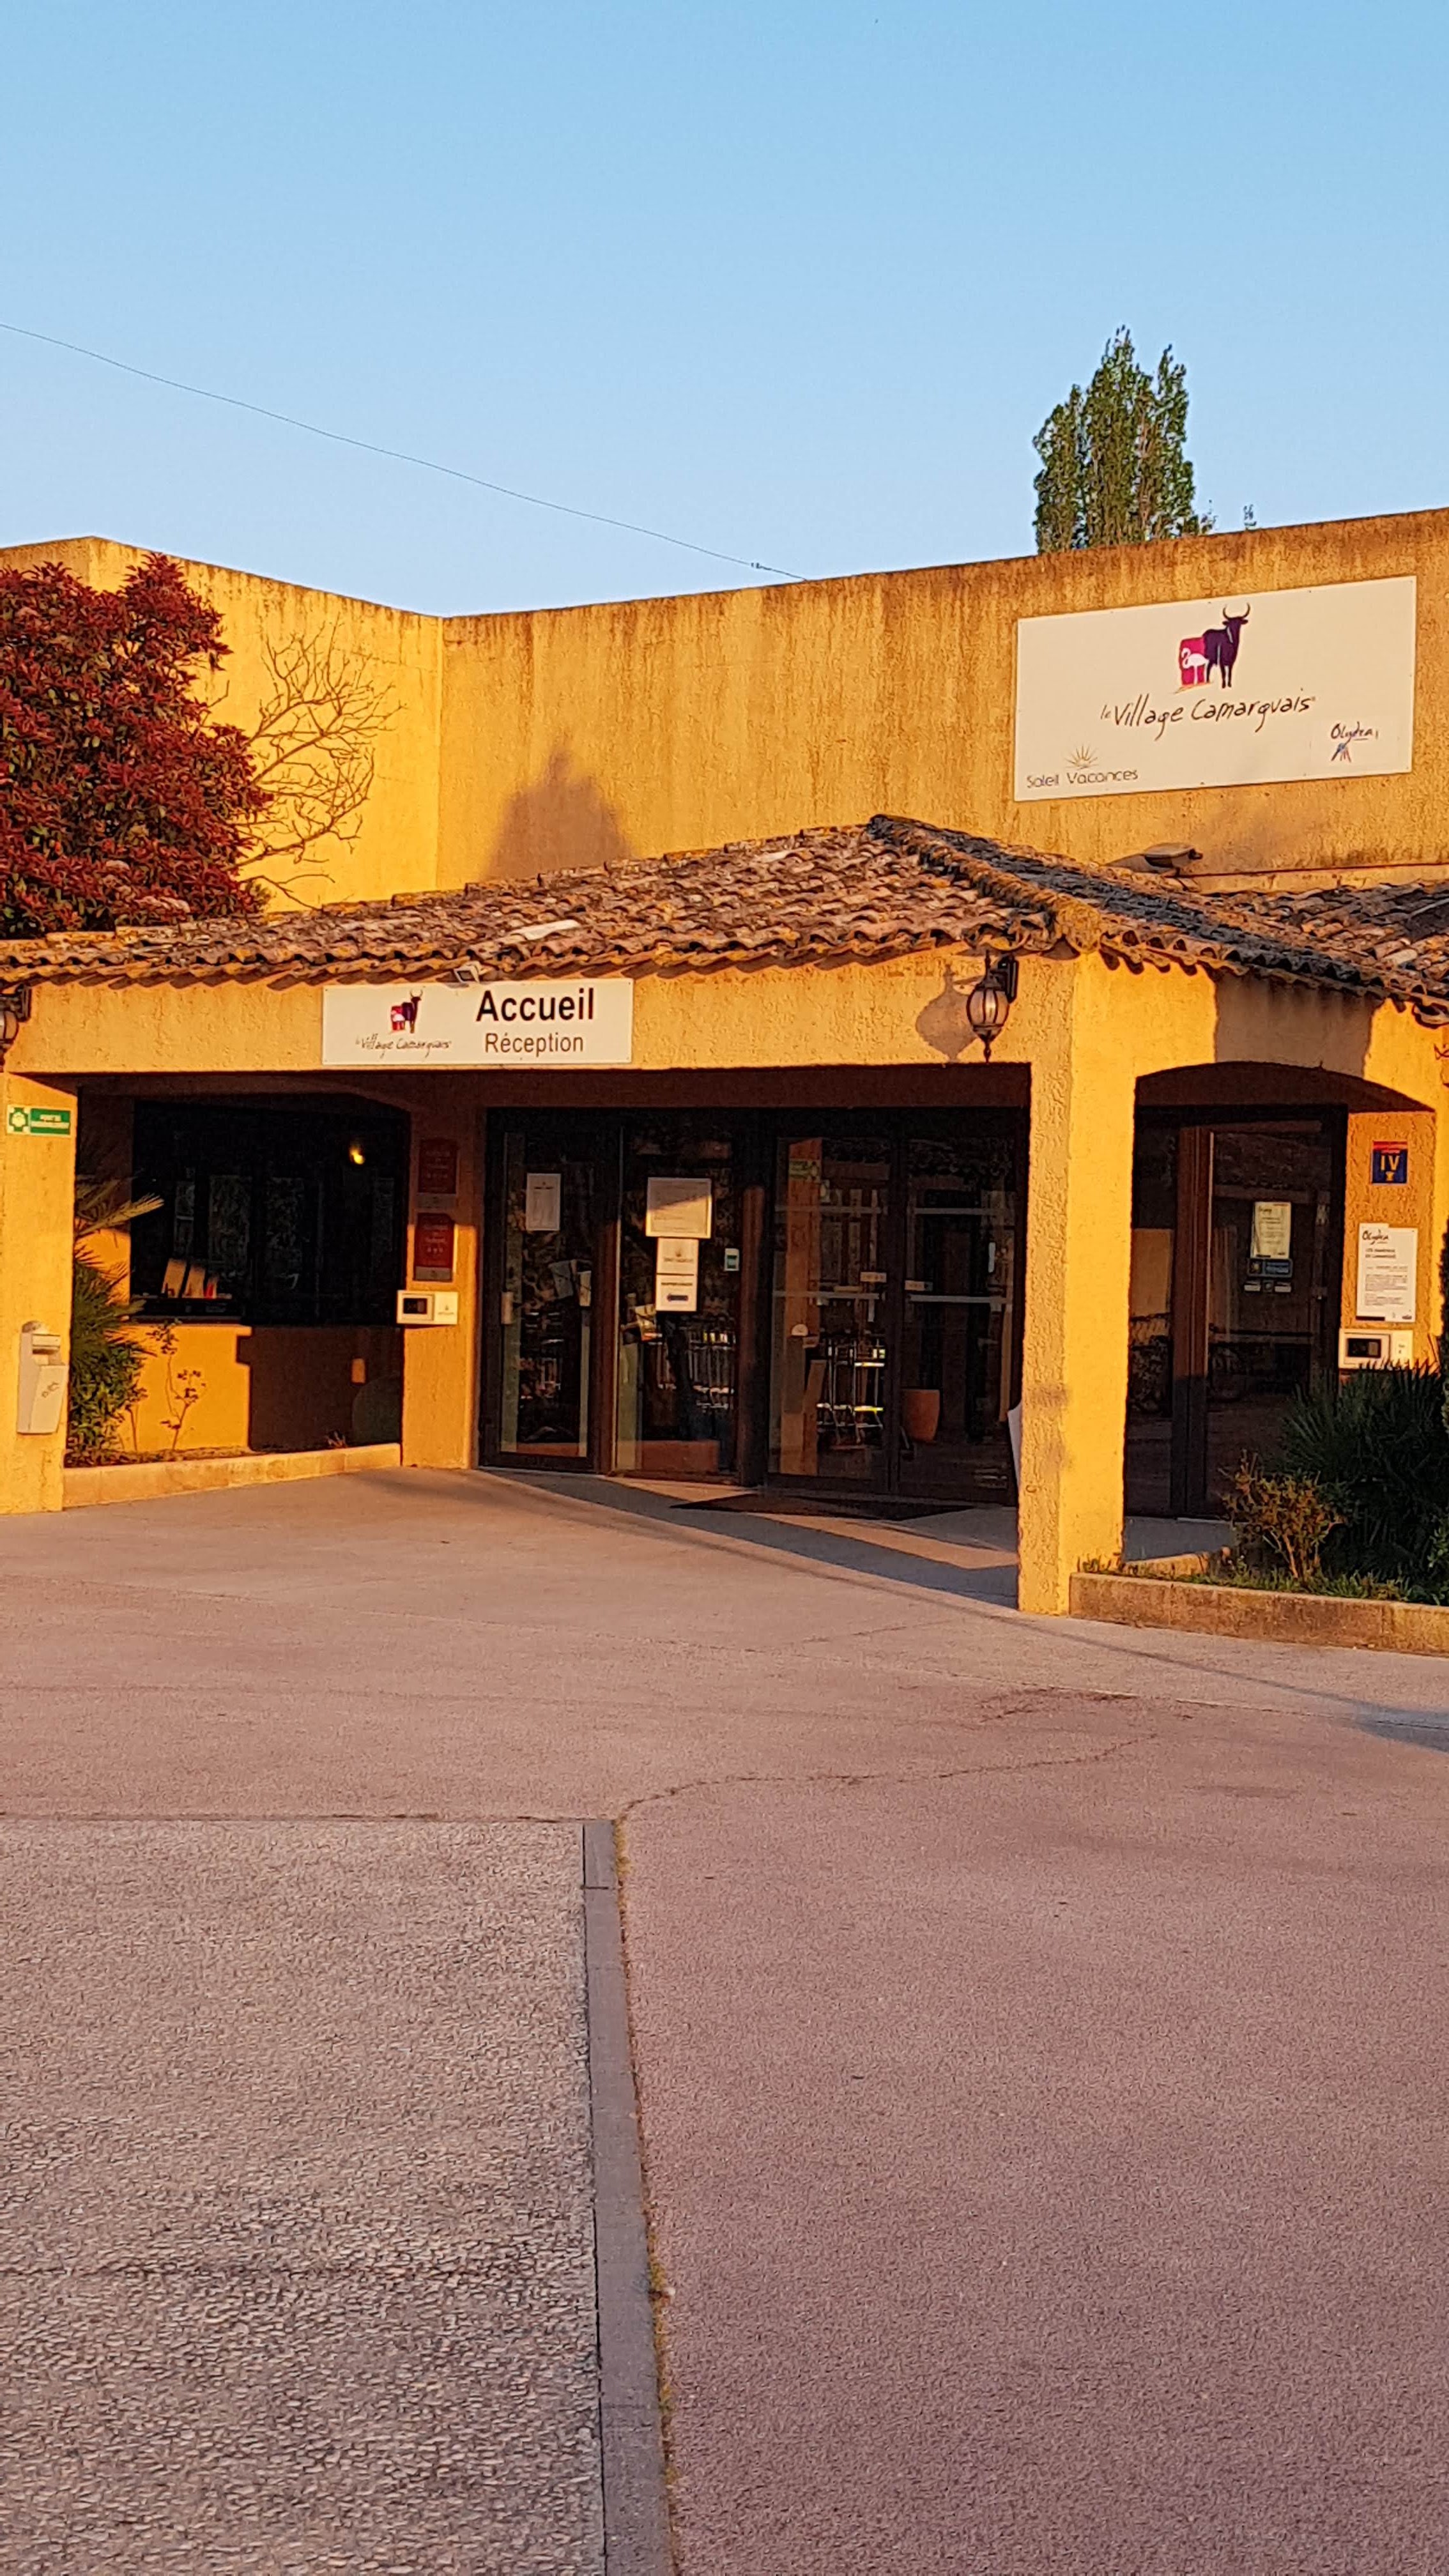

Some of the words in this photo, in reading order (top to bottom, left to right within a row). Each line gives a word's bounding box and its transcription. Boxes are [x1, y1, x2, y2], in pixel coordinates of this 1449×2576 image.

[1114, 693, 1184, 742] Village
[1191, 687, 1310, 733] Camarguais
[1066, 769, 1138, 785] Vacances
[476, 987, 594, 1022] Accueil
[485, 1032, 584, 1057] Réception
